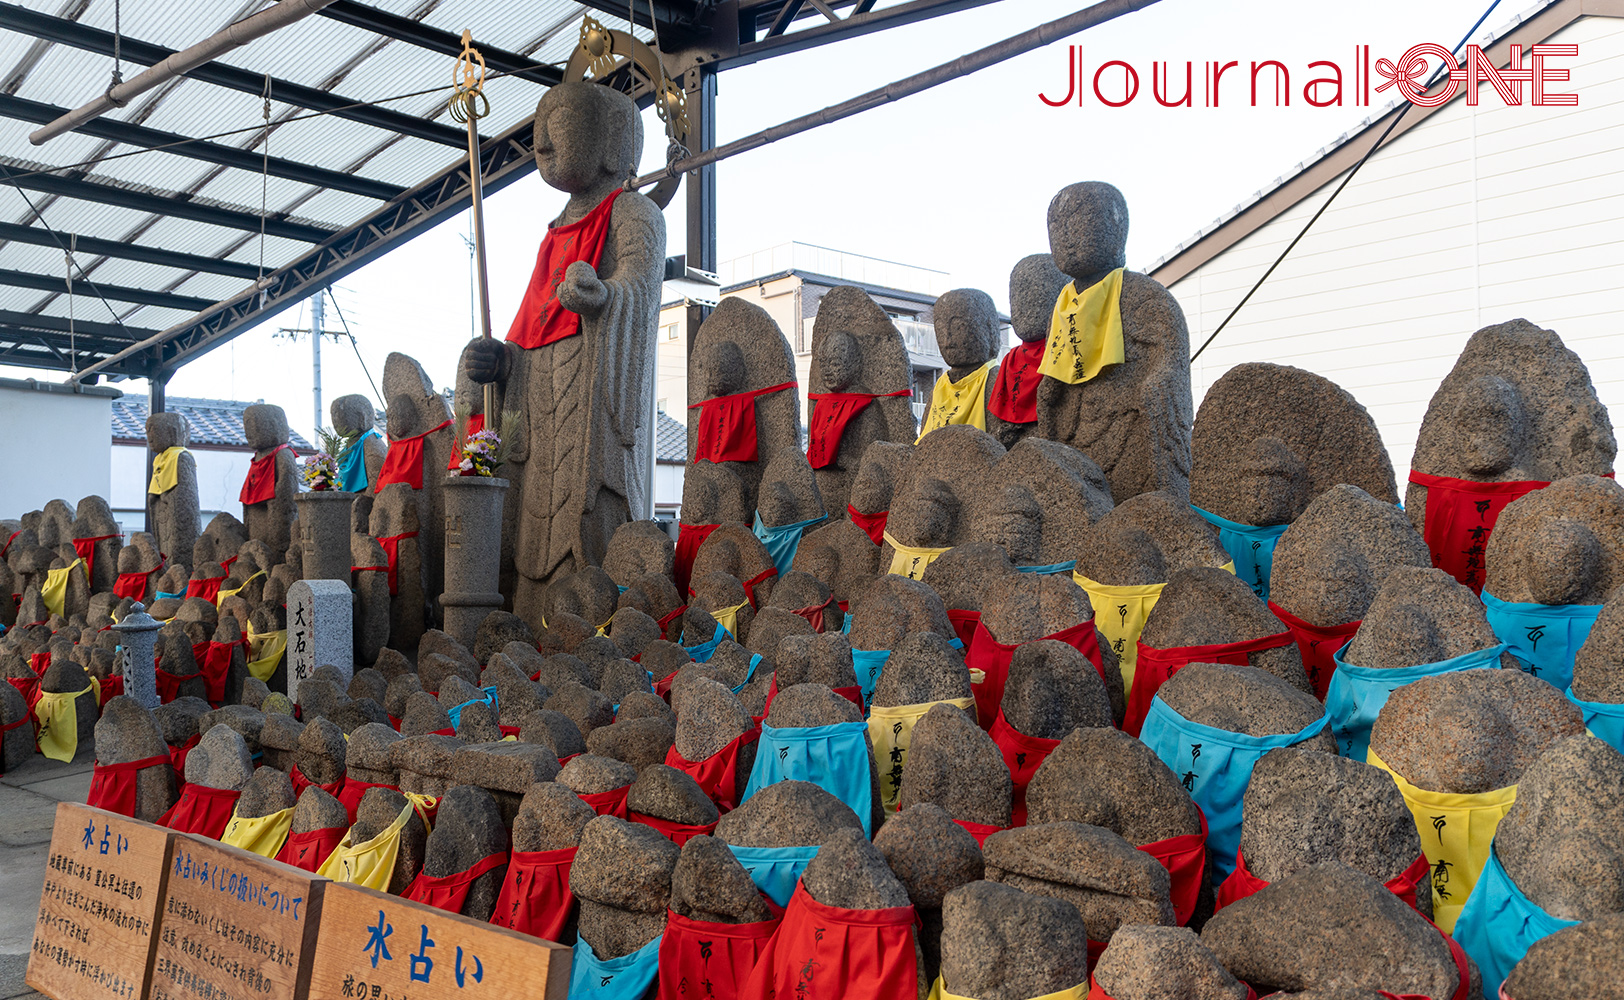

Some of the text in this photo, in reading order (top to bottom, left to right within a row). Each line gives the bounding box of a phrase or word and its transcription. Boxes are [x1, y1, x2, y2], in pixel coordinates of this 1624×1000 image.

[81, 819, 129, 855] 水占い
[174, 850, 302, 920] 水占いみくじの扱いについて
[362, 910, 483, 988] 水占い
